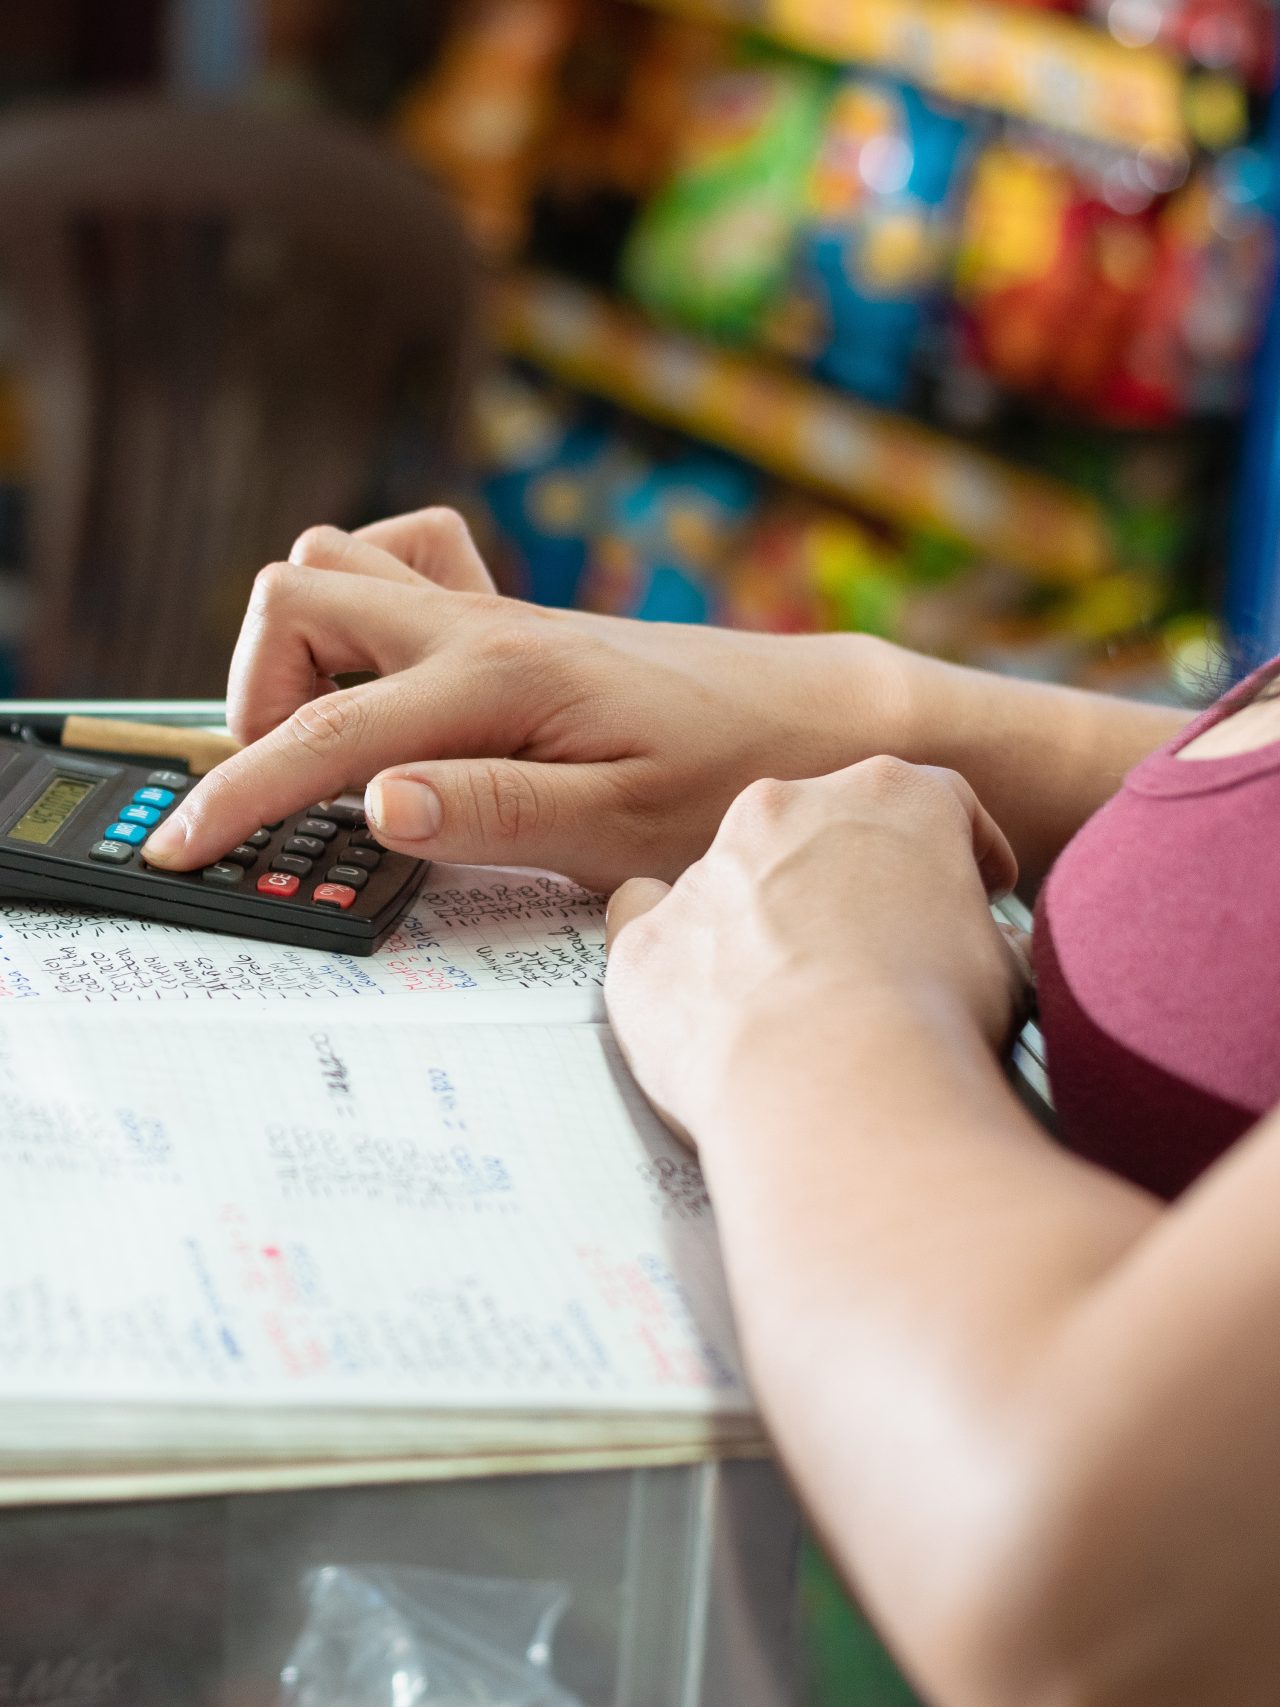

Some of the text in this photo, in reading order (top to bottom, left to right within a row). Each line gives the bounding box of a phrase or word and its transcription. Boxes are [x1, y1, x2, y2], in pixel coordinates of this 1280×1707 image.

[306, 820, 329, 829] 3
[99, 840, 122, 853] OFF
[294, 838, 317, 848] 2
[282, 855, 305, 864] 1
[268, 872, 293, 886] CE
